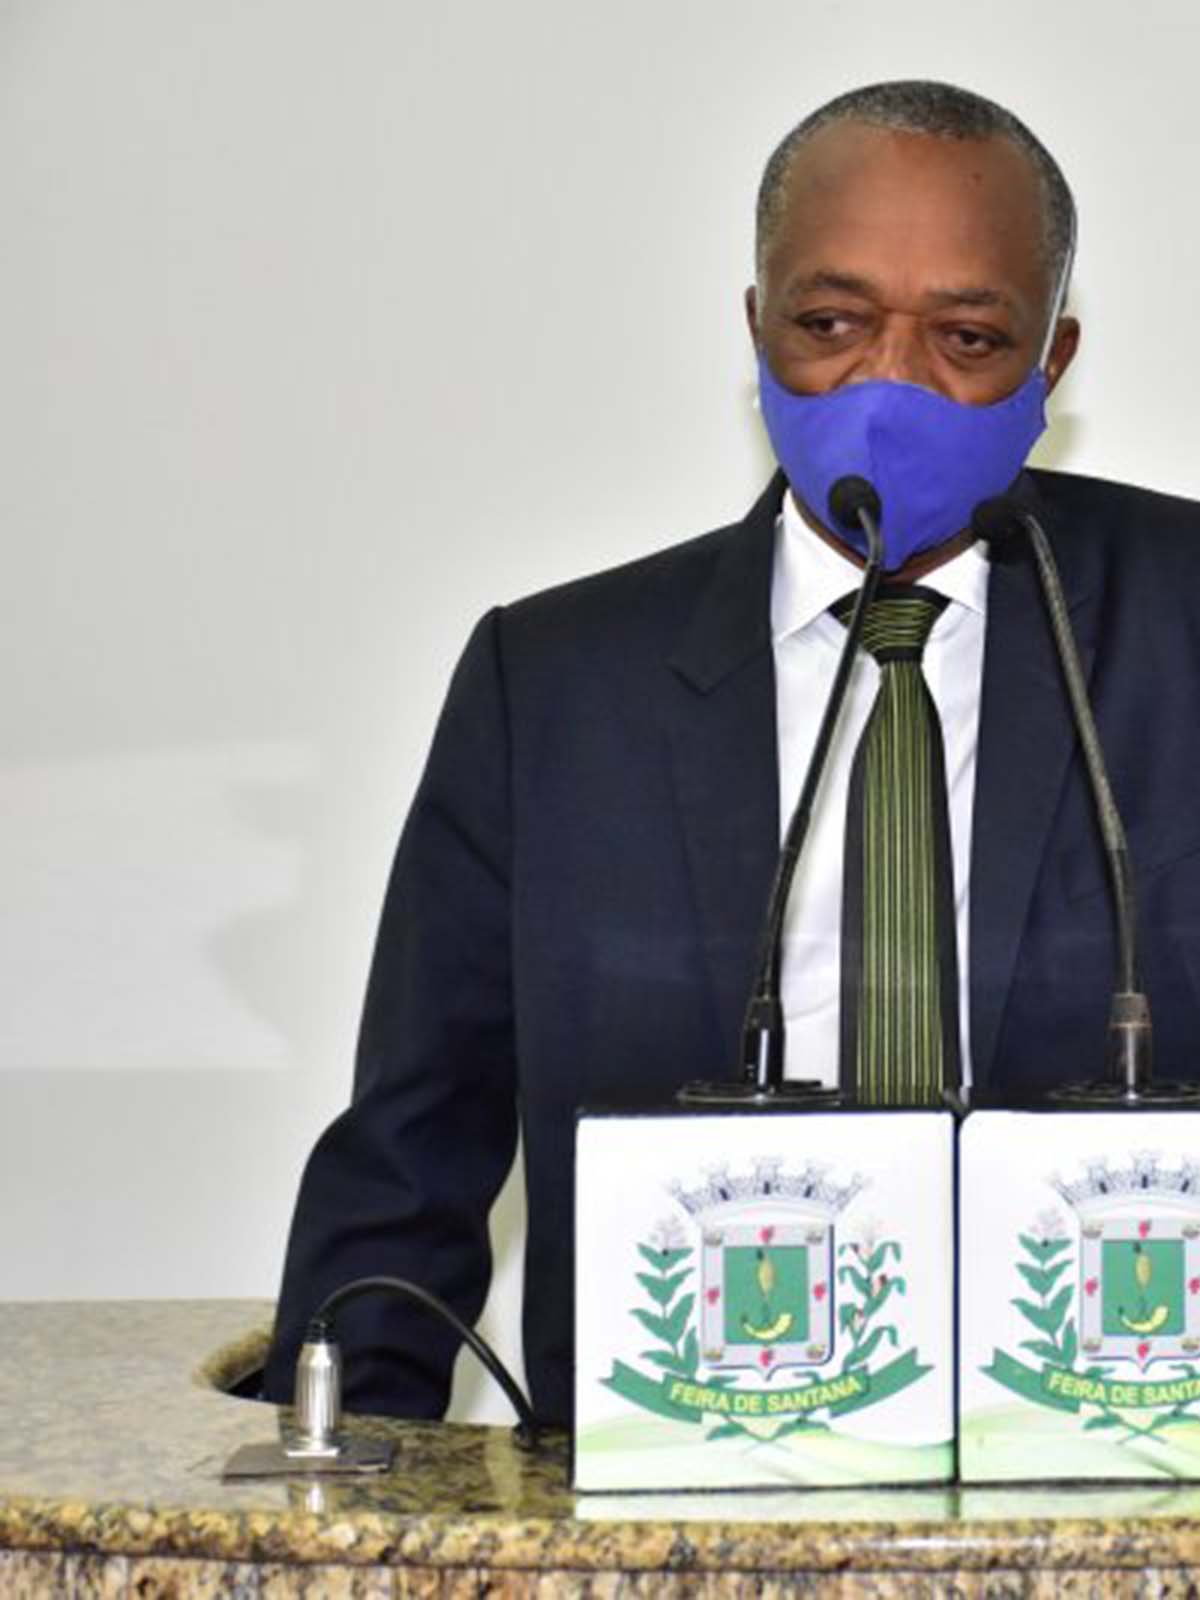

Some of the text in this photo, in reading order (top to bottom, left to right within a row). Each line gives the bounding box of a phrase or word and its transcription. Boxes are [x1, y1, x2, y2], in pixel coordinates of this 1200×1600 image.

[671, 1376, 862, 1413] FEIRA DE SANTANA
[1048, 1373, 1107, 1401] FEIRA
[1110, 1384, 1140, 1403] DE
